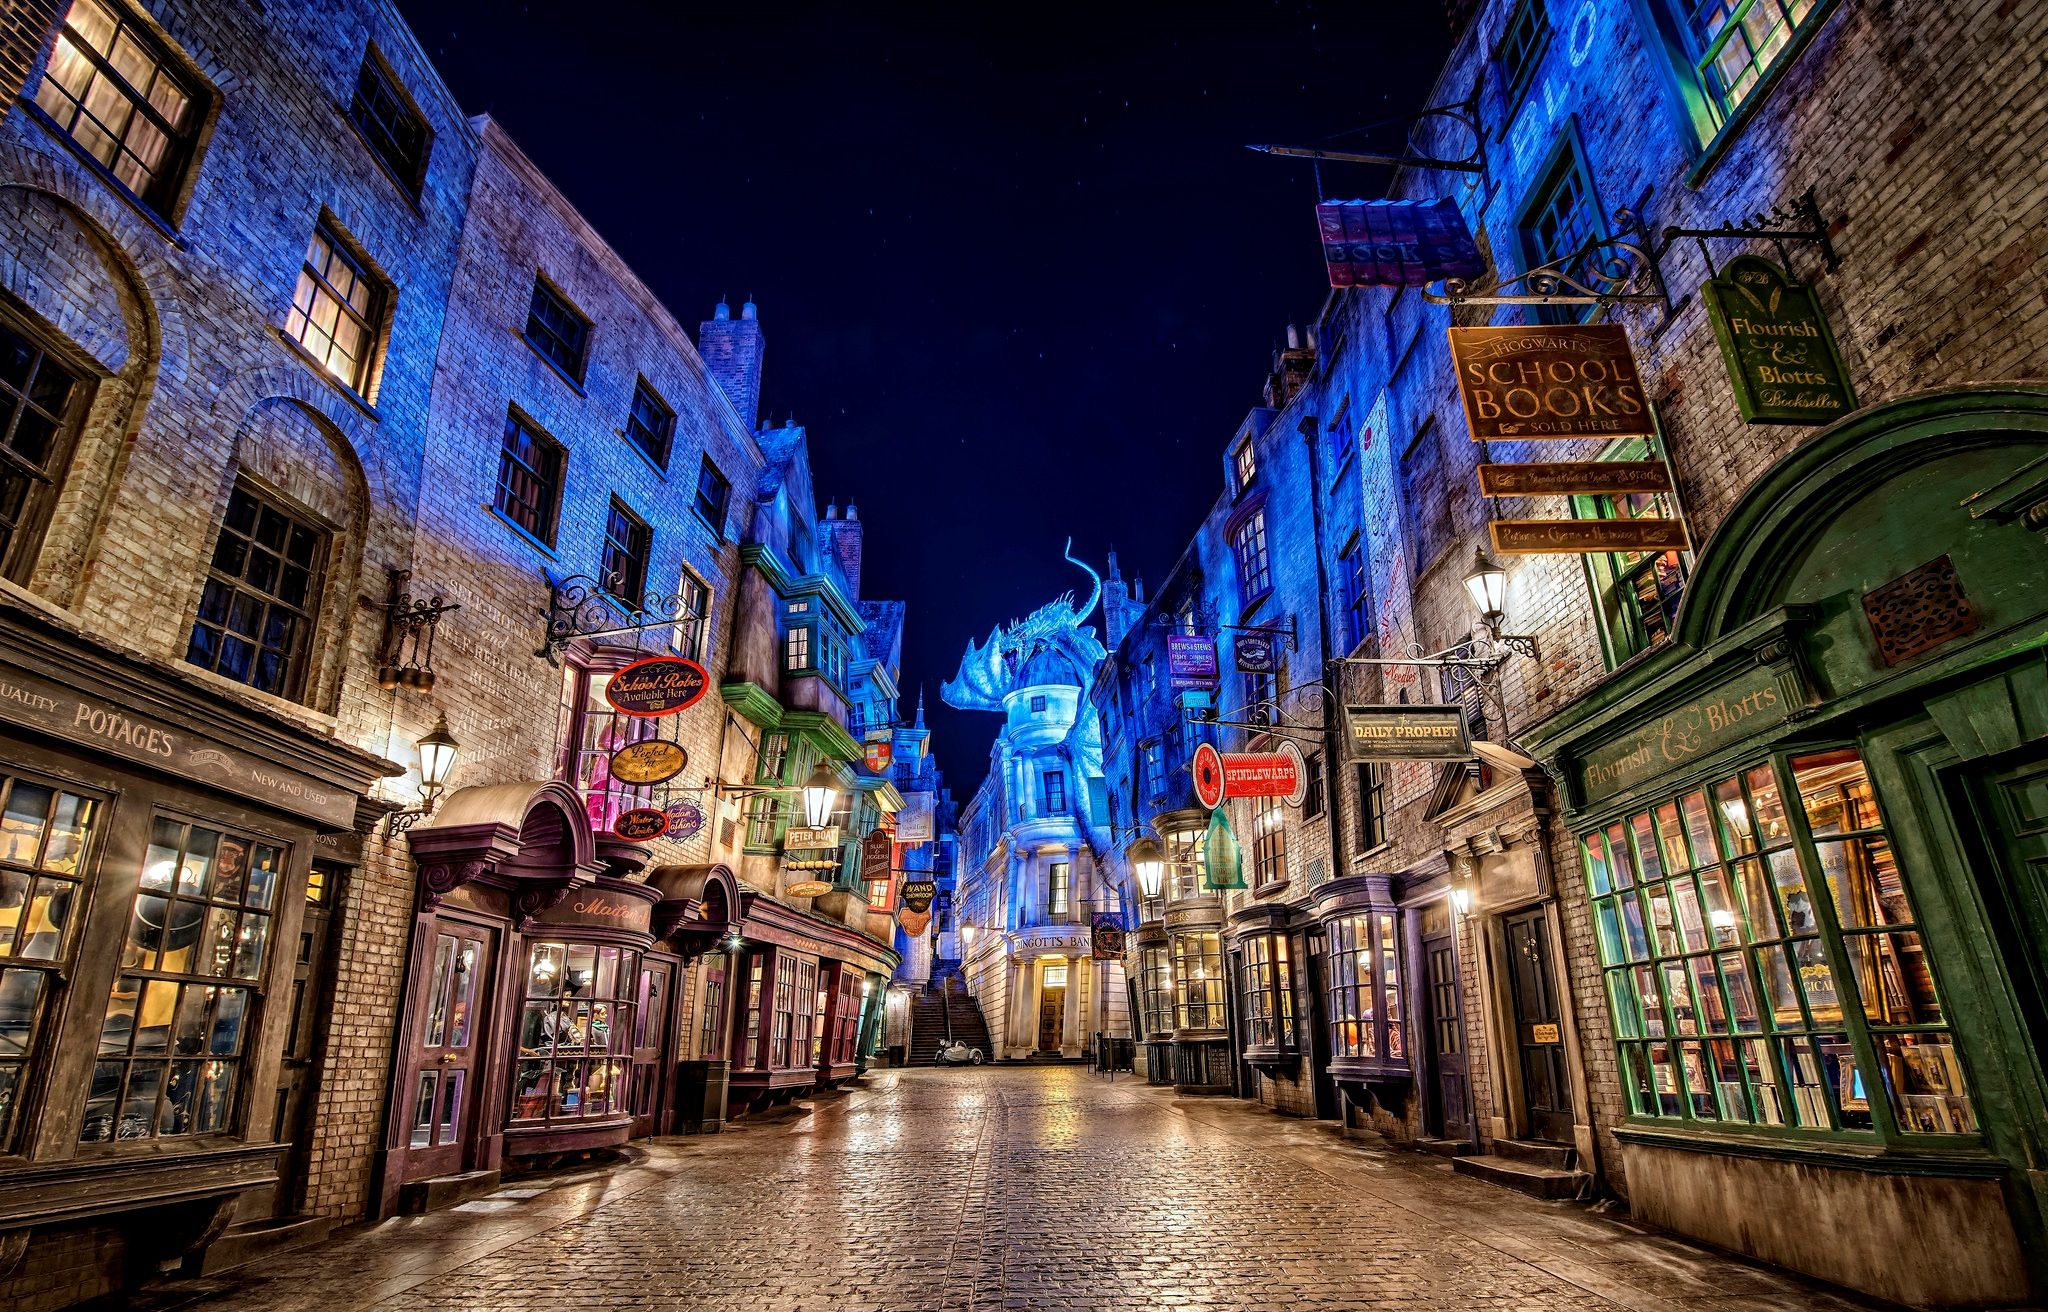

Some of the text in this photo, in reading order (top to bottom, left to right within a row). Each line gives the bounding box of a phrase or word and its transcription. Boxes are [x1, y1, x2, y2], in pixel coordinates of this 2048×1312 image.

[1731, 318, 1819, 337] Flourish
[1499, 336, 1586, 355] HOGWARTS
[1468, 359, 1631, 386] SCHOOL
[1758, 365, 1826, 385] Blotts
[1472, 385, 1641, 419] BOOKS
[1530, 419, 1622, 432] SOLD HERE
[481, 630, 510, 649] and
[612, 672, 702, 692] School Robes
[1384, 664, 1416, 683] Needles
[623, 688, 687, 702] Available Here
[1354, 726, 1458, 738] DAILY PROPHET
[1586, 743, 1650, 789] Flourish
[1706, 687, 1777, 732] Blotts
[1226, 767, 1295, 781] SPINDLEWARPS
[789, 831, 813, 845] PETER
[906, 884, 933, 892] WAND
[1070, 936, 1092, 947] BAN
[1786, 980, 1835, 993] MGICAL
